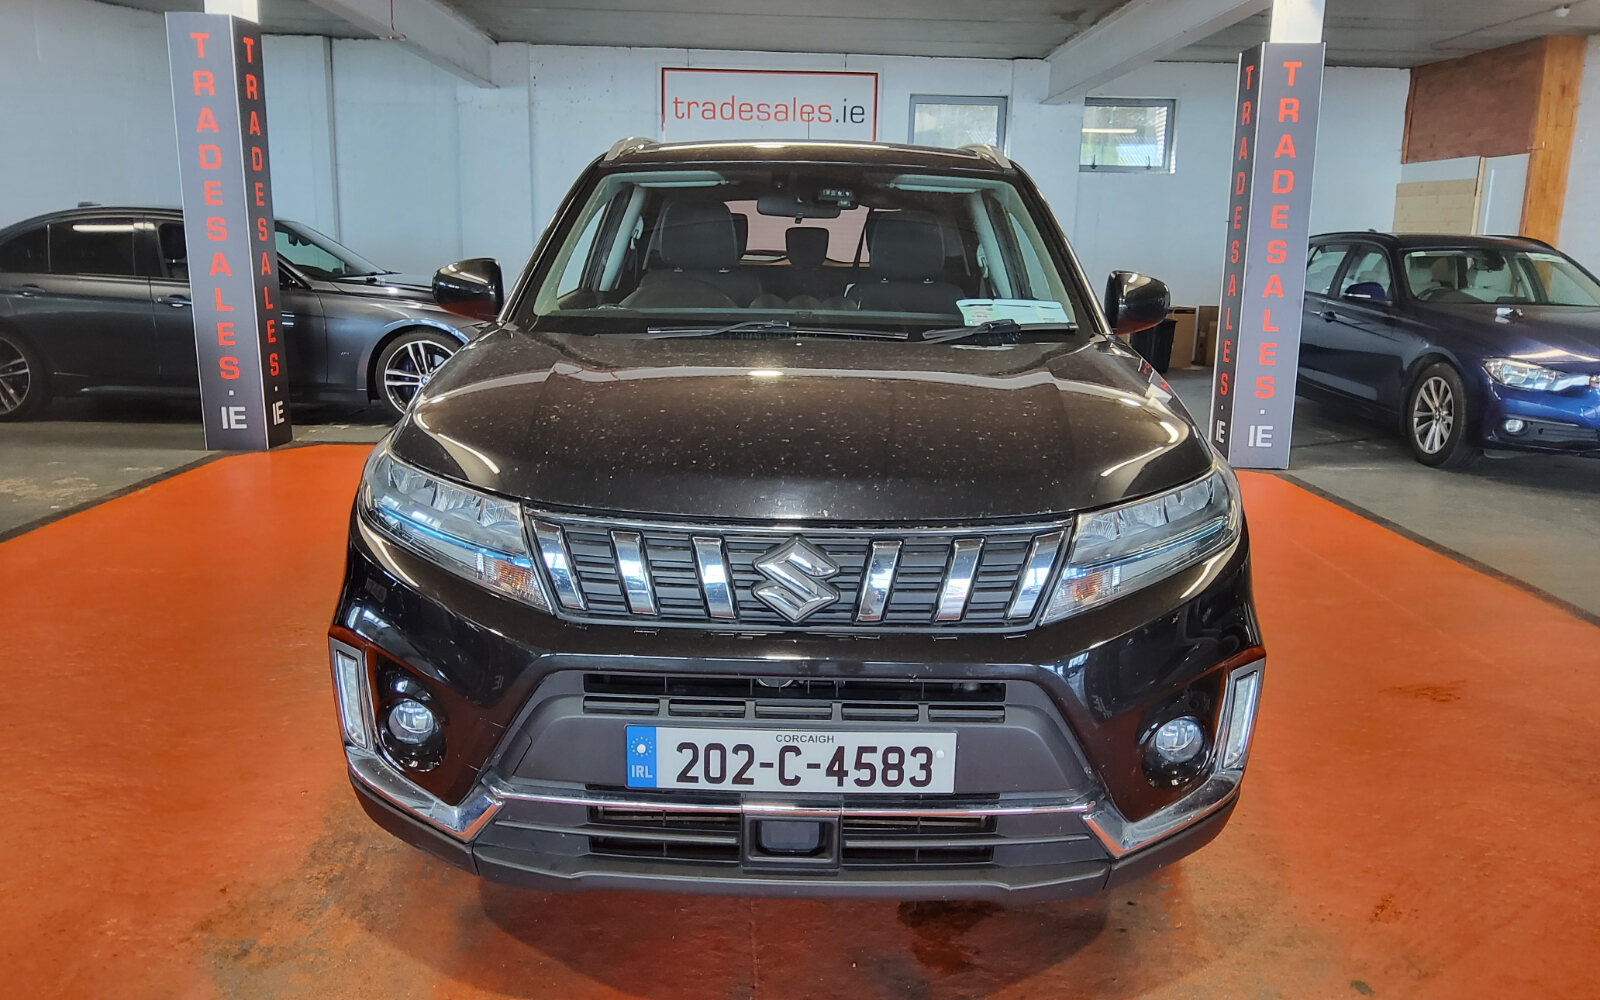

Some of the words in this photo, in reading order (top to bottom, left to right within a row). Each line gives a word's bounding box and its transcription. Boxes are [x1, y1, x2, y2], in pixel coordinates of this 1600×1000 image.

[673, 95, 866, 124] tradesales.ie
[775, 734, 835, 744] CORCAIGH
[631, 764, 653, 778] IRL
[675, 741, 934, 788] 202-C-4583
